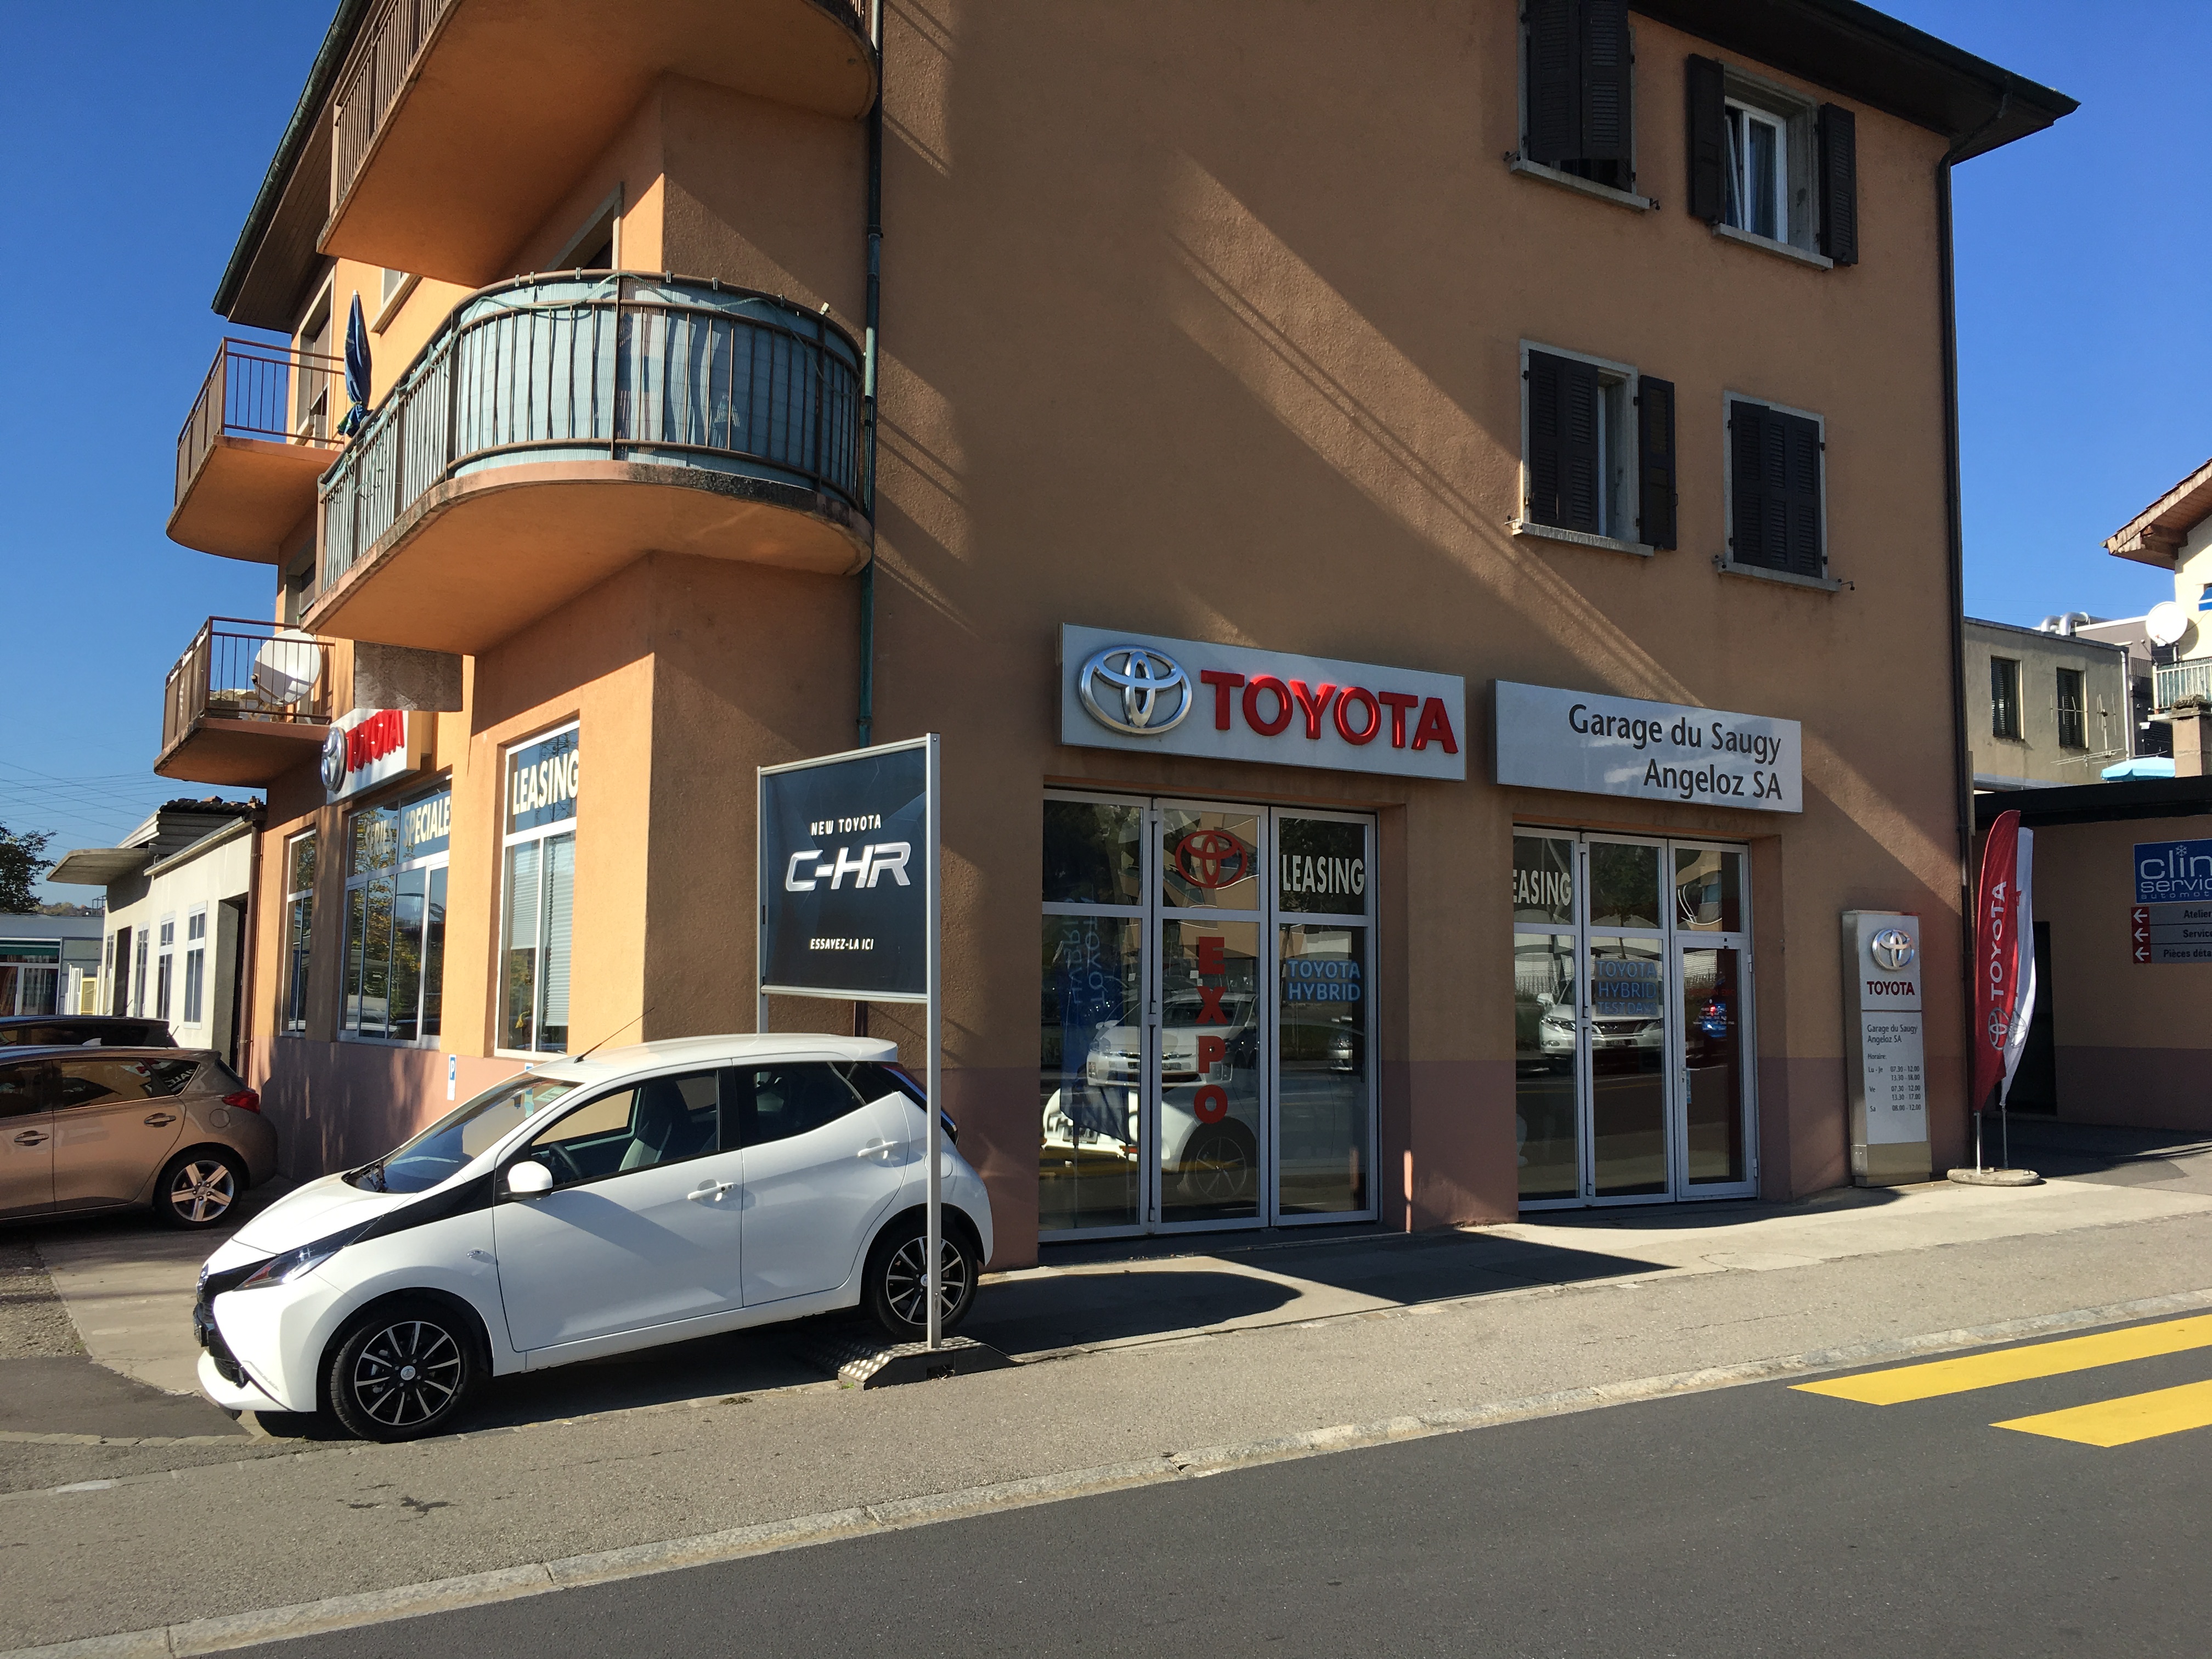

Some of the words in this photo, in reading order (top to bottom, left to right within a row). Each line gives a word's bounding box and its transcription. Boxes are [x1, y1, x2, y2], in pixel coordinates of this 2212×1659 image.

[1201, 669, 1459, 754] TOYOTA
[345, 709, 405, 774] TOYOTA
[1568, 704, 1662, 750] Garage
[1671, 716, 1701, 748] du
[1711, 722, 1781, 766] Saugy
[513, 749, 580, 815] LEASING
[1644, 758, 1745, 799] Angeloz
[1752, 771, 1783, 800] SA
[403, 795, 451, 847] SPECIALE
[811, 819, 833, 837] NEW
[838, 814, 882, 833] TOYOTA
[785, 841, 911, 892] C-HR
[1283, 854, 1364, 895] LEASING
[2184, 909, 2212, 919] Atelier
[810, 938, 859, 950] ESSAYEZ-LA
[862, 938, 874, 950] ICI
[1990, 881, 2007, 1001] TOYOTA
[2163, 949, 2191, 958] Pièces
[1288, 960, 1361, 979] TOYOTA
[1596, 960, 1657, 978] TOYOTA
[1288, 982, 1361, 1001] HYBRID
[1599, 981, 1657, 998] HYBRID
[1866, 980, 1916, 996] TOYOTA
[1599, 1002, 1627, 1014] TEST
[1627, 1002, 1657, 1015] DAYS
[1194, 936, 1228, 1124] EXPO
[1867, 1024, 1889, 1034] Garage
[1900, 1024, 1917, 1034] Saugy
[1867, 1035, 1892, 1045] Angeloz
[450, 1060, 455, 1078] P
